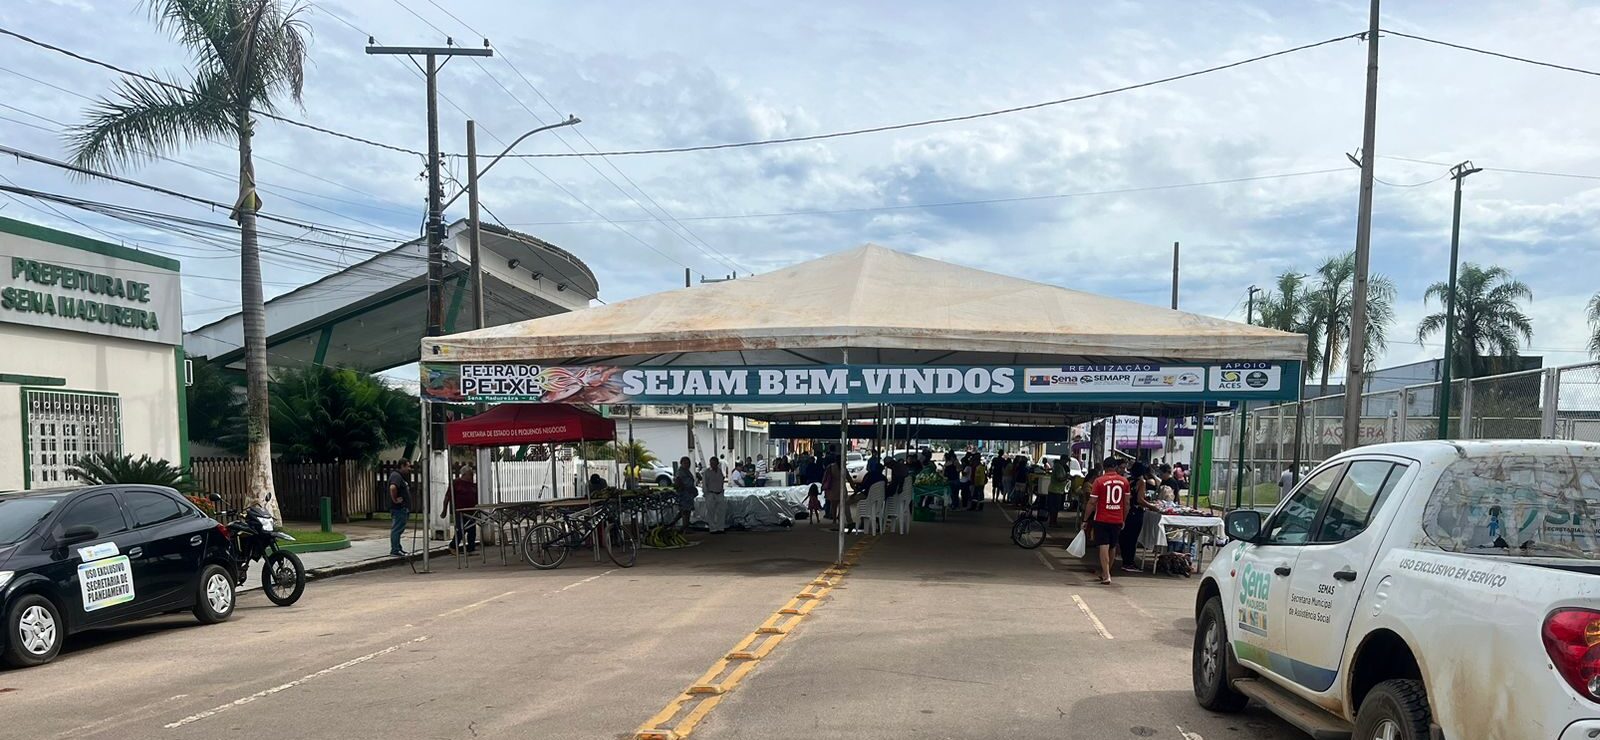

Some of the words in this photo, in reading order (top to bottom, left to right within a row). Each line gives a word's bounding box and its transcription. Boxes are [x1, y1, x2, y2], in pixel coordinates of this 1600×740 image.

[12, 257, 125, 298] PREFEITURA
[126, 280, 150, 302] DE
[1, 286, 56, 315] SENA
[58, 296, 159, 330] MADUREIRA
[461, 365, 515, 377] FEIRA
[518, 365, 540, 377] DO
[1069, 363, 1152, 373] REALIZAÇÃO
[462, 378, 540, 394] PEIXE
[622, 369, 748, 395] SEJAM
[758, 368, 1015, 395] BEM-VINDOS
[1051, 375, 1078, 384] Sena
[462, 430, 486, 438] SECRETARIA
[493, 429, 510, 437] ESTADO
[518, 427, 542, 436] PEQUENOS
[1106, 485, 1122, 504] 10
[85, 568, 97, 579] USO
[97, 562, 125, 577] EXCLUSIVO
[1399, 558, 1415, 570] USO
[1414, 560, 1456, 578] EXCLUSIVO
[1454, 568, 1470, 580] EM
[1467, 570, 1507, 588] SERVIÇO
[86, 575, 120, 592] SECRETARIA
[120, 573, 128, 584] DE
[1240, 563, 1270, 605] Sena
[1317, 583, 1335, 595] SEMAS
[88, 584, 130, 603] PLANEJAMENTO
[1291, 593, 1311, 605] Secretaria
[1311, 597, 1332, 609] Municipal
[1289, 607, 1294, 615] de
[1294, 608, 1316, 621] Assistência
[1316, 612, 1331, 624] Social
